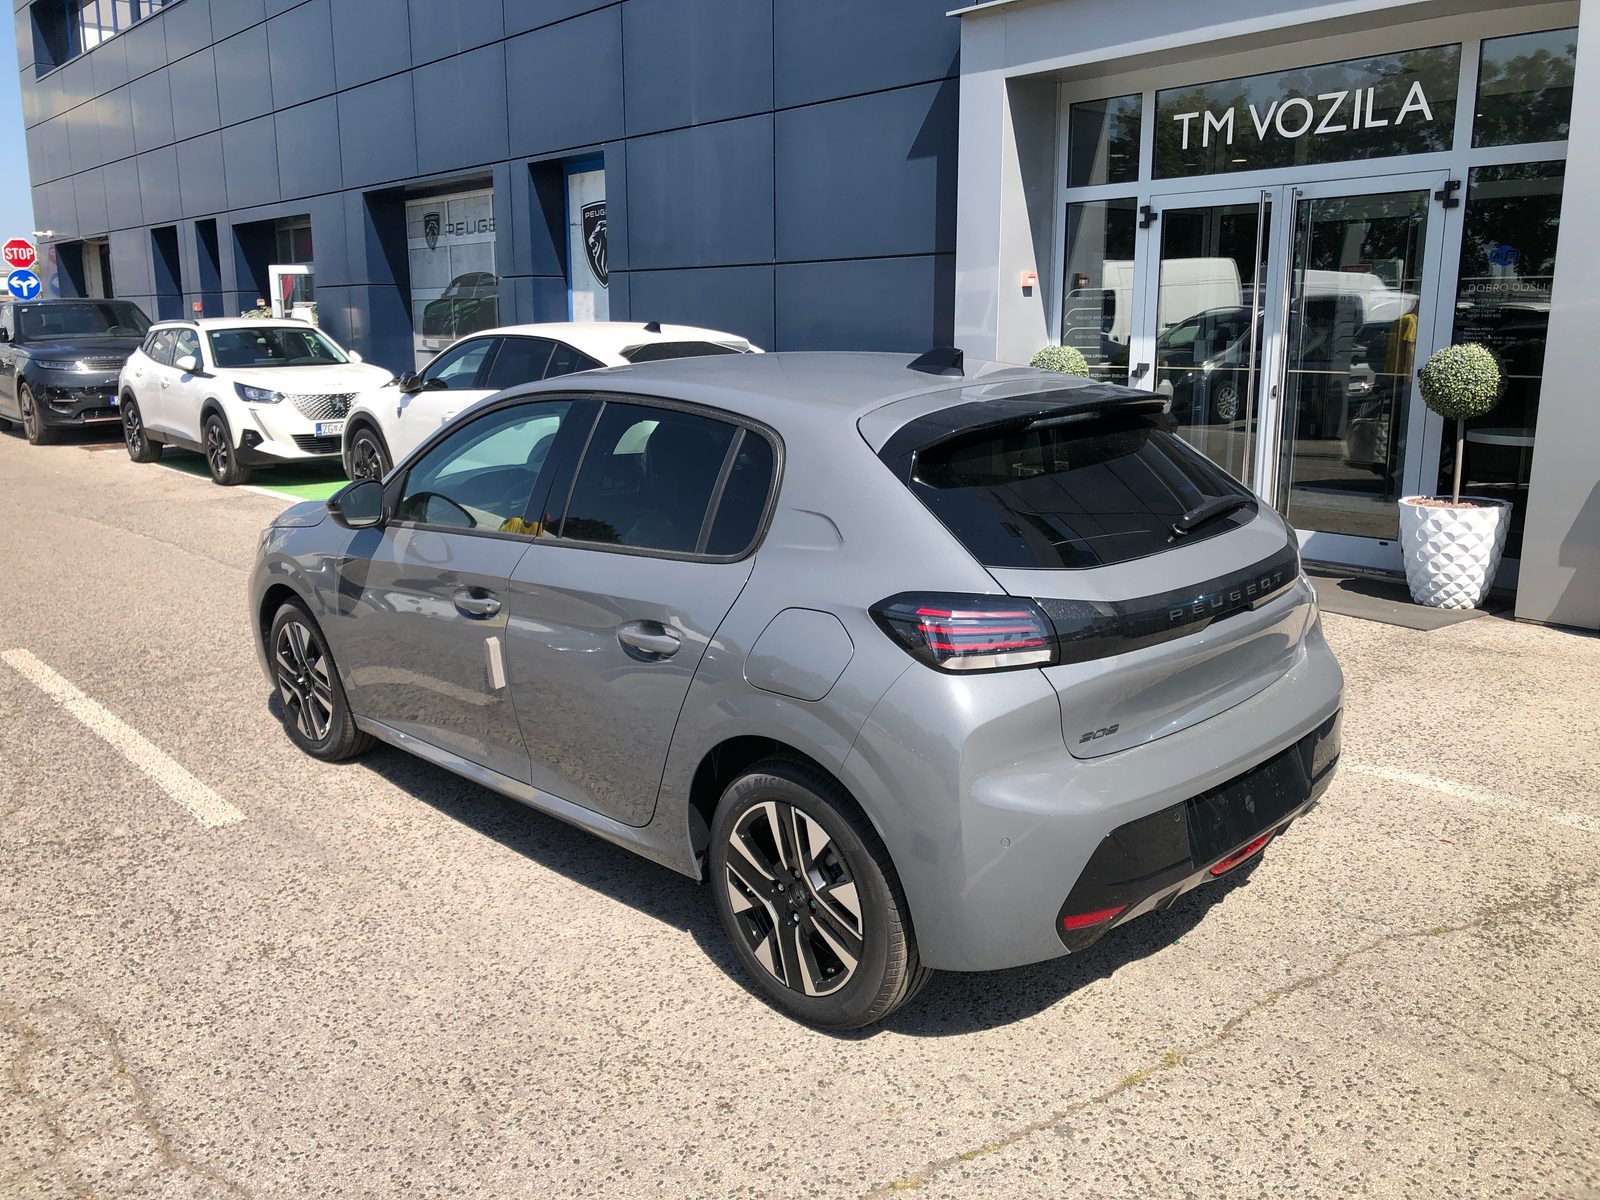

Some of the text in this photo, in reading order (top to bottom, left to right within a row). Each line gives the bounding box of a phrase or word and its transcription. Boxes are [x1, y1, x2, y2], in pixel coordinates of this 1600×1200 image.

[1173, 80, 1433, 150] TM VOZILA
[5, 247, 34, 260] STOP
[1468, 280, 1546, 293] DOBRO DOŠLI
[1169, 572, 1283, 621] PEUGEOT
[1079, 723, 1119, 744] 208
